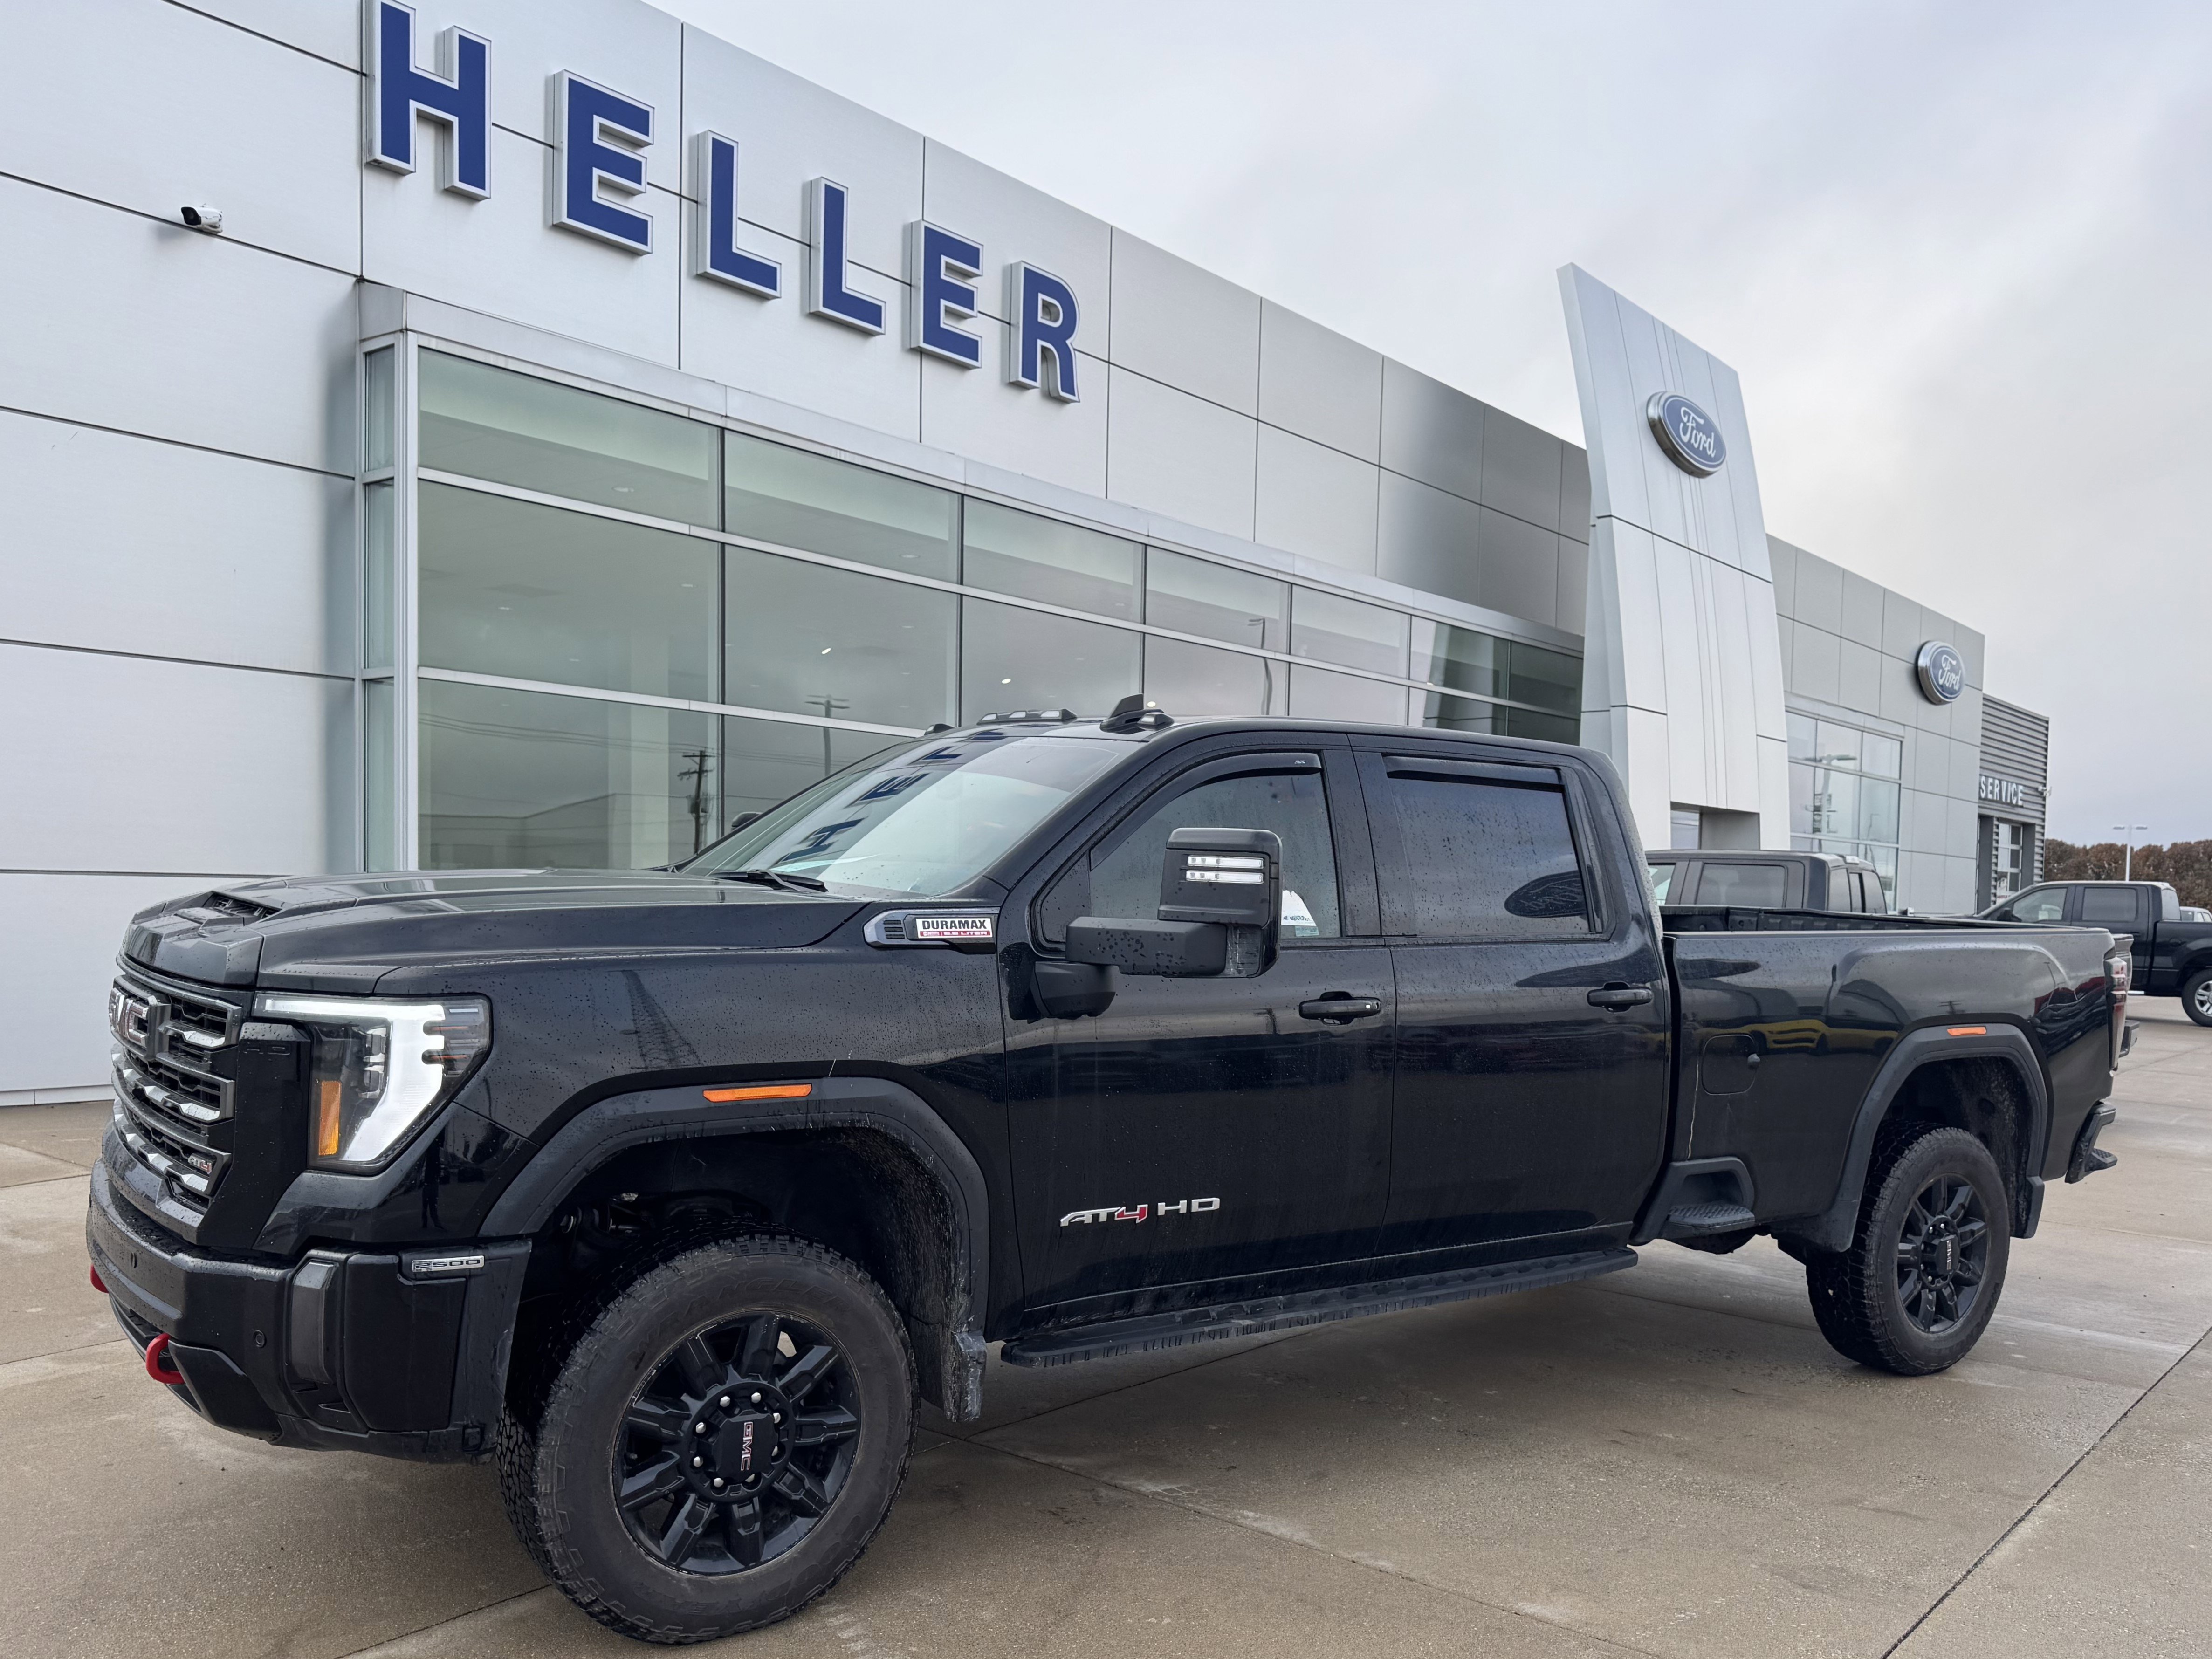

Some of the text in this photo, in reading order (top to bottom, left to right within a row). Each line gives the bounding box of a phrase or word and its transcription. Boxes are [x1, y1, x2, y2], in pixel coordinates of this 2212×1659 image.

[366, 0, 1080, 404] HELLER
[1679, 407, 1716, 458] Ford
[1938, 654, 1962, 691] Ford
[1980, 775, 2024, 806] SERVICE
[922, 919, 987, 930] DURAMAX
[187, 1155, 212, 1175] AT4
[1060, 1197, 1220, 1227] AT4 HD
[414, 1259, 481, 1269] 2500
[740, 1421, 754, 1471] GMC
